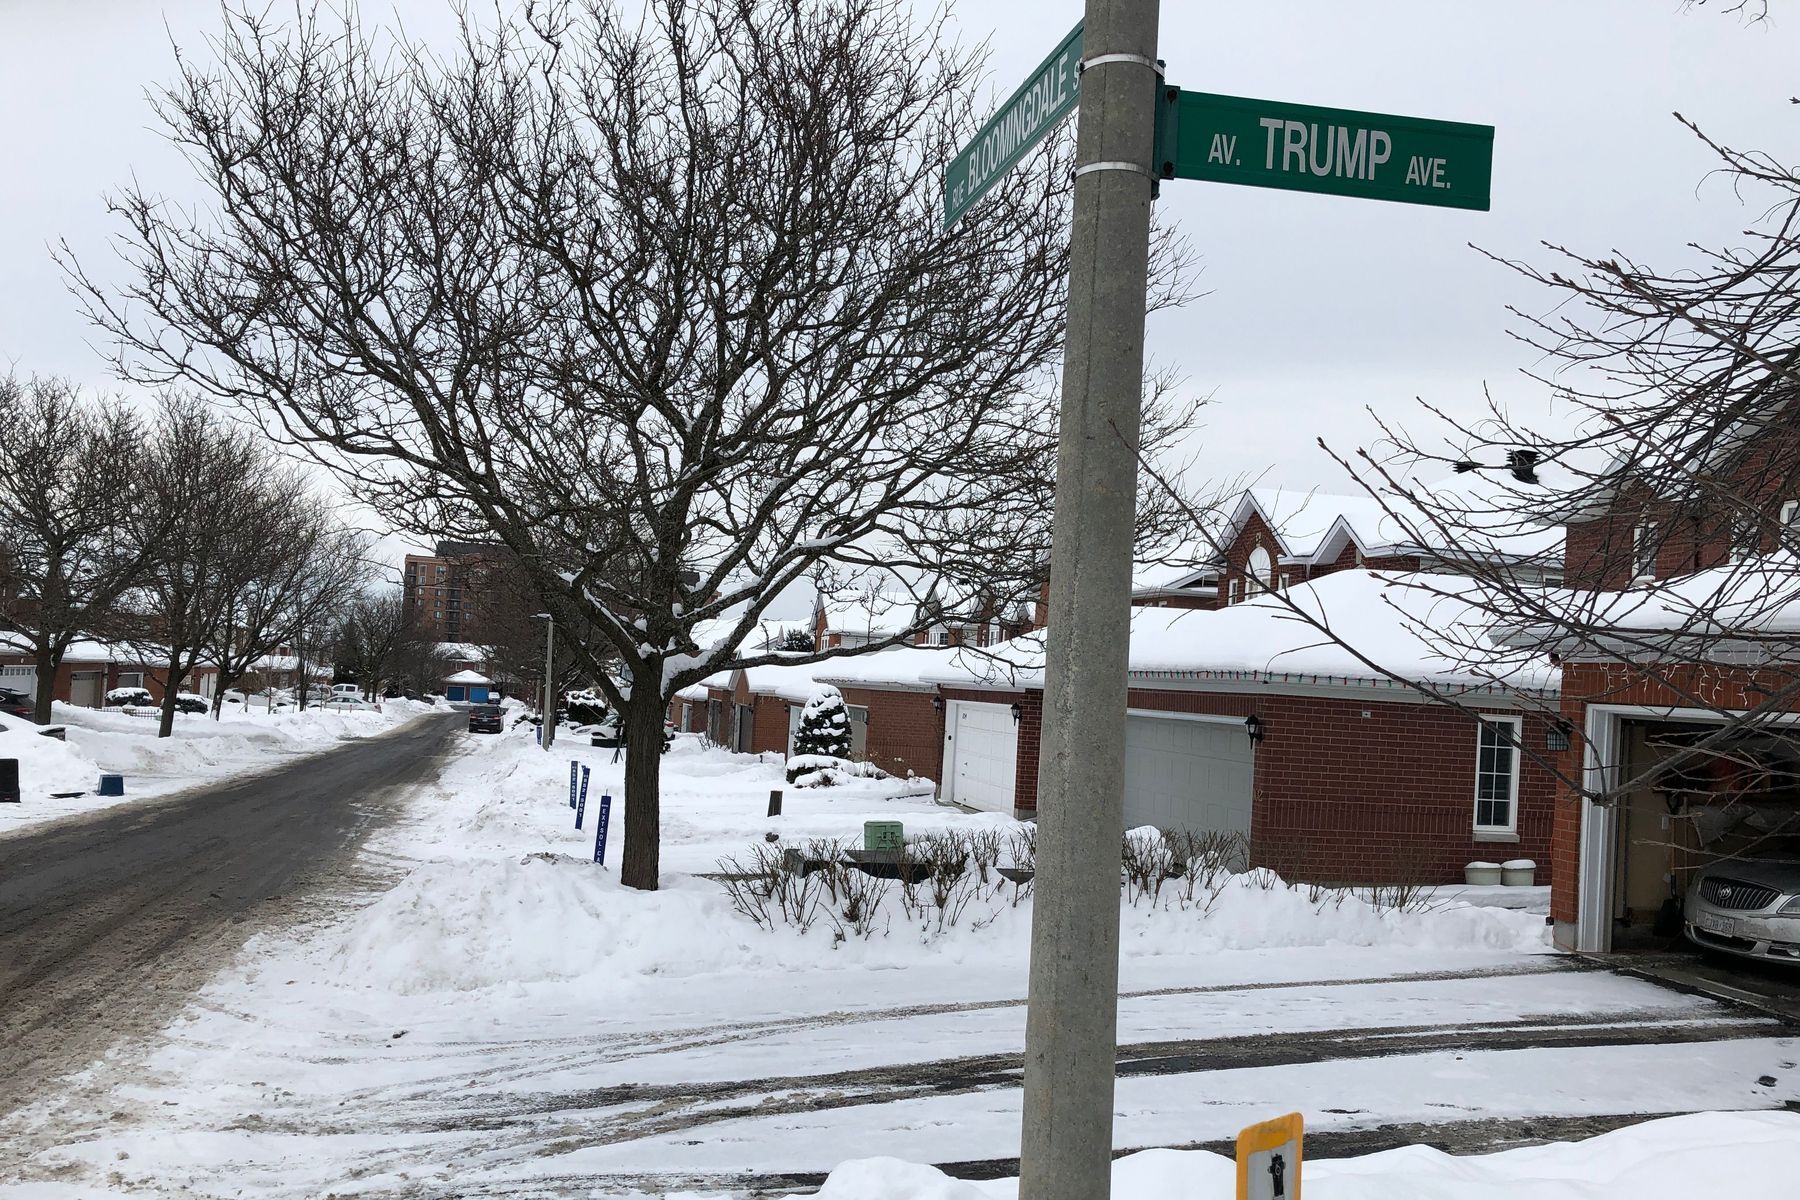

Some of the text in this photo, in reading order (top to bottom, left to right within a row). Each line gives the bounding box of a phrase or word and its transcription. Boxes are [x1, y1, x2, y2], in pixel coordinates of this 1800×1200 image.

[952, 52, 1083, 212] RUE BLOOMINGDALE S
[1208, 117, 1451, 189] AV. TRUMP AVE.
